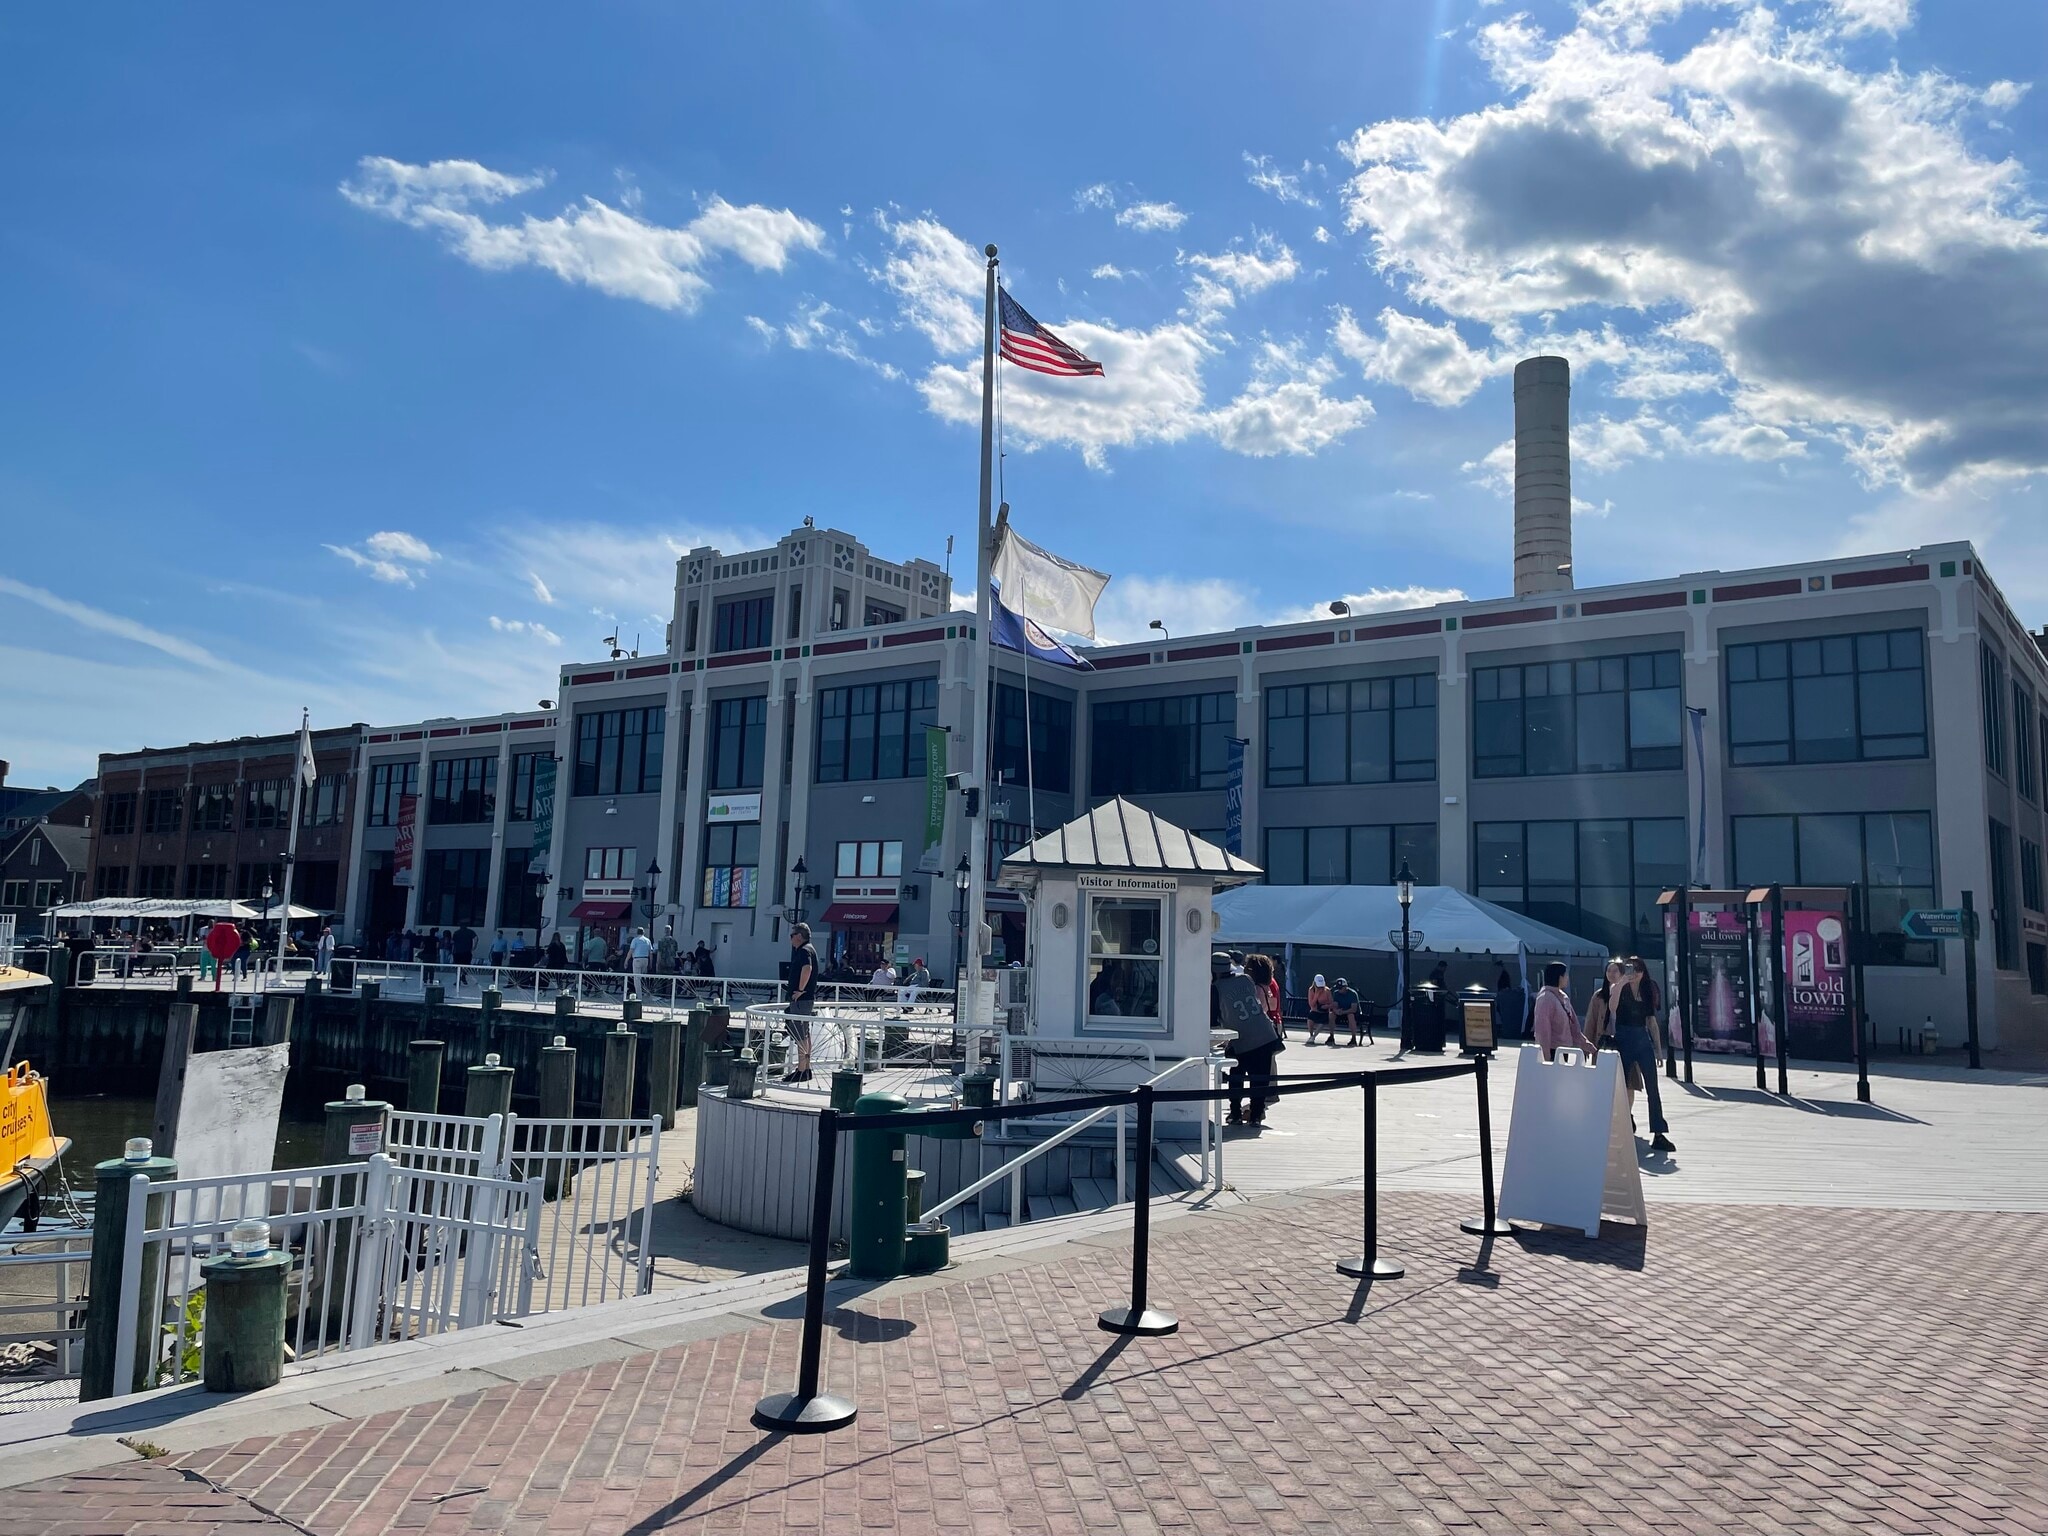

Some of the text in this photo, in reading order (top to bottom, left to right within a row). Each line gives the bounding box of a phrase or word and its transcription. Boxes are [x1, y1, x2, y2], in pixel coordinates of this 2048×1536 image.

[930, 785, 938, 826] TORPEDO
[1226, 784, 1242, 811] ART
[396, 823, 415, 842] ART
[732, 879, 742, 893] ART
[749, 880, 757, 893] AR
[1080, 877, 1176, 889] Visitor Information
[1701, 930, 1741, 941] old town
[1818, 976, 1844, 992] old
[1792, 987, 1846, 1006] town
[1233, 995, 1261, 1021] 33
[1793, 1005, 1845, 1013] ALEXANDRIA
[2, 1100, 17, 1119] city
[1, 1115, 27, 1138] cruises
